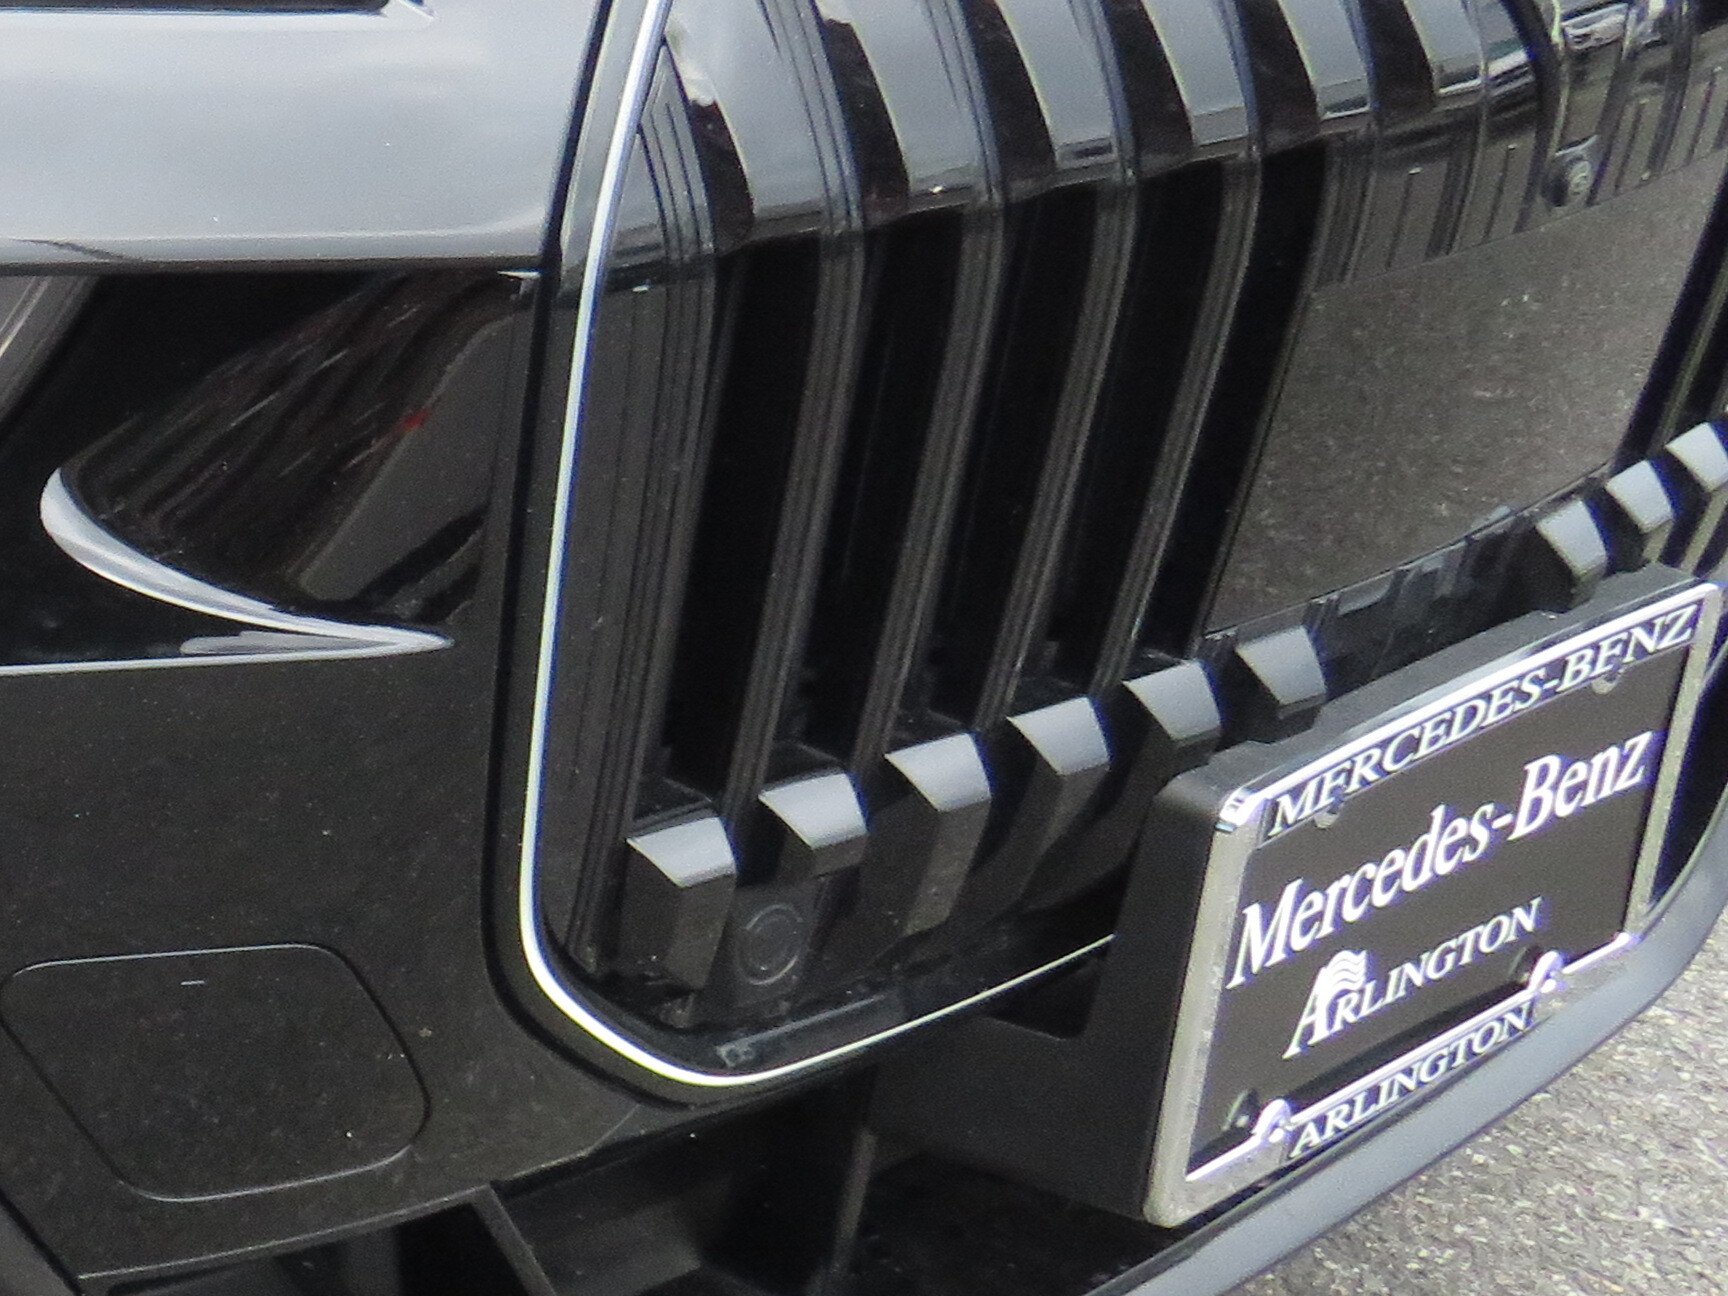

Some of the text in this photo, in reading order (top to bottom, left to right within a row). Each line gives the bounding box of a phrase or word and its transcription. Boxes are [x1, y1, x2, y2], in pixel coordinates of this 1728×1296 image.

[1268, 603, 1700, 838] MERCEDES-BENZ
[1225, 729, 1653, 990] Mercedes-Benz
[1282, 896, 1542, 1060] ARLINGTON
[1289, 1001, 1533, 1159] ARLINGTON
